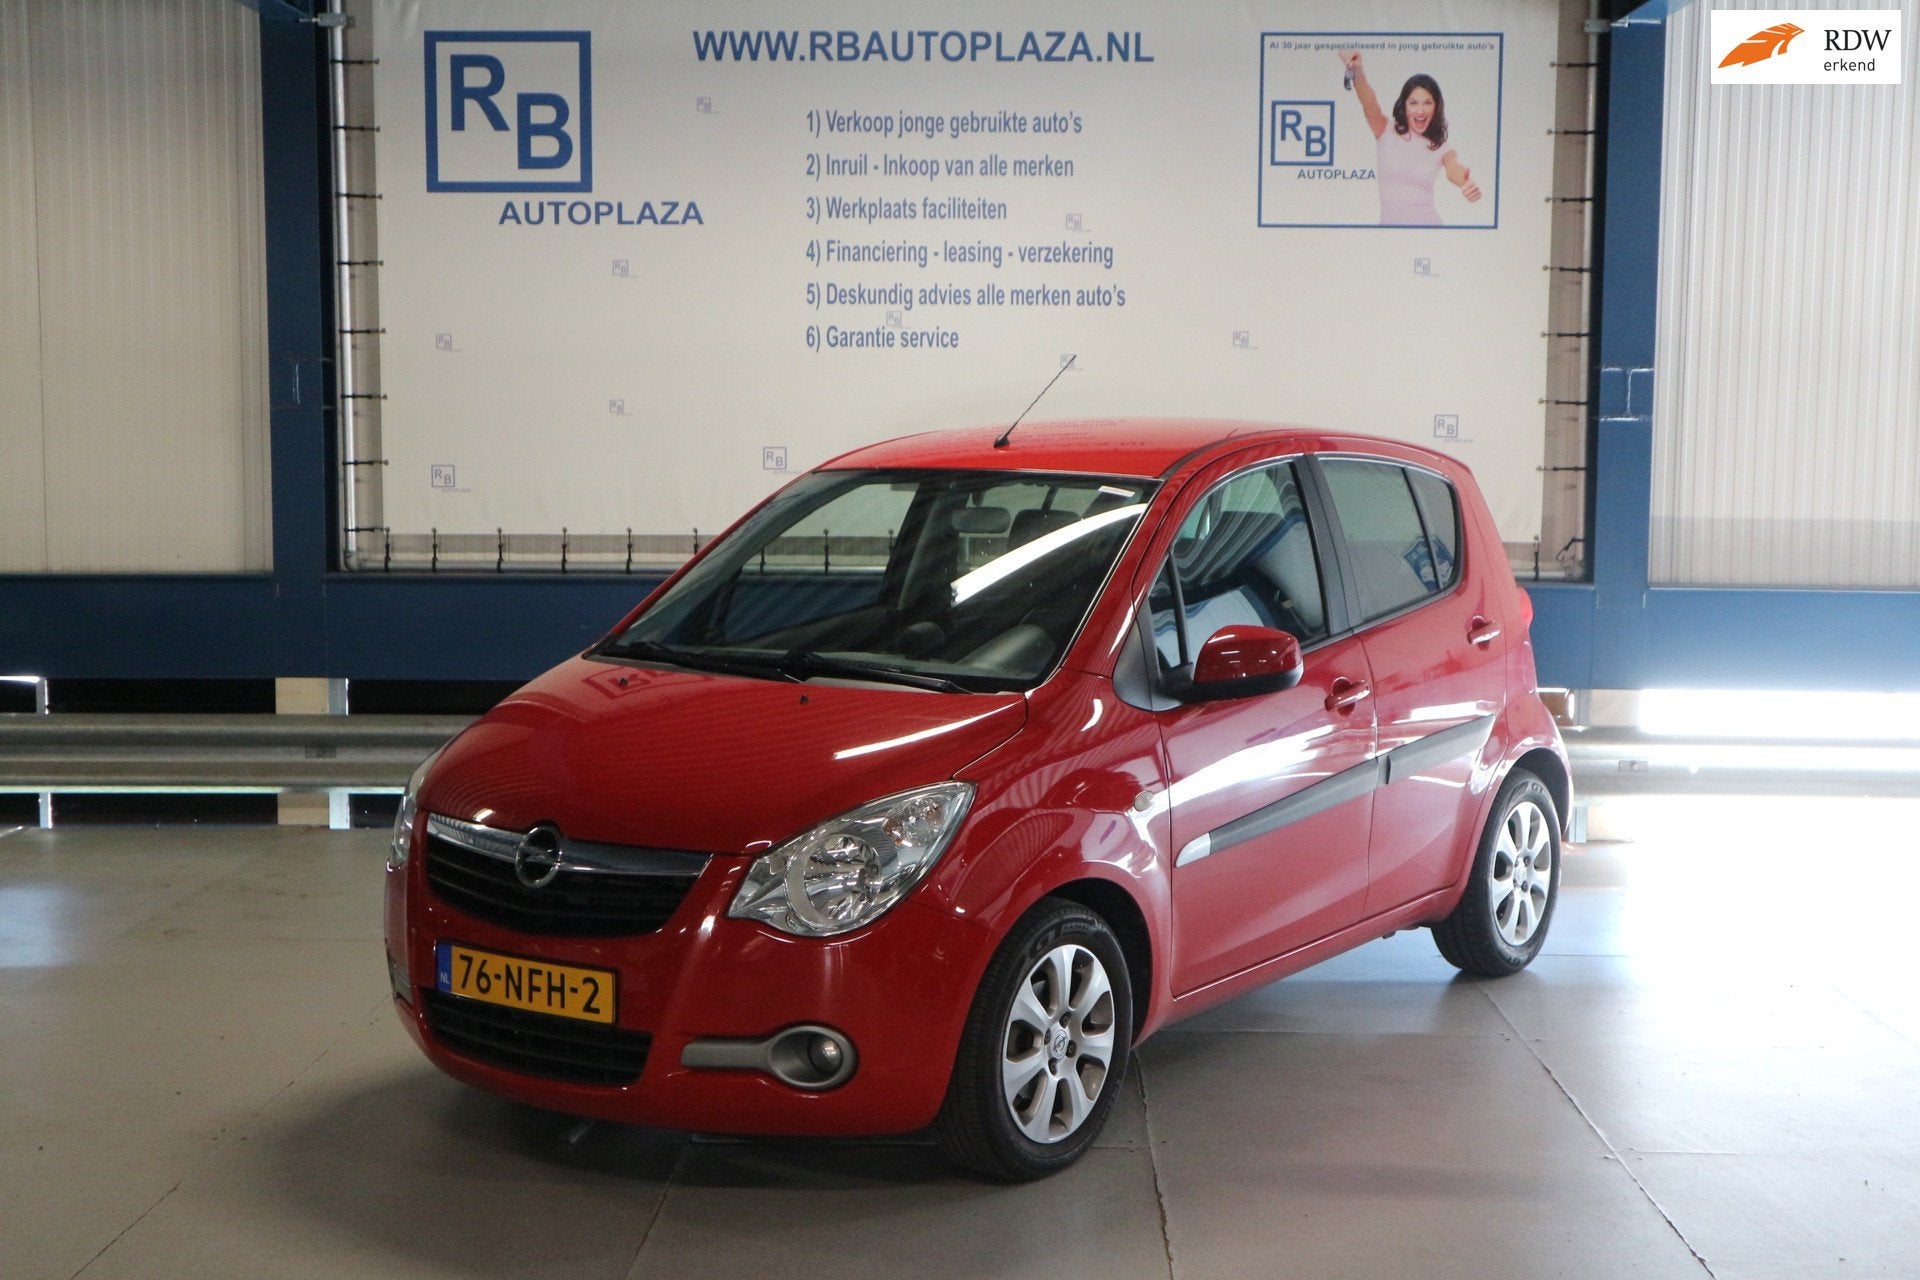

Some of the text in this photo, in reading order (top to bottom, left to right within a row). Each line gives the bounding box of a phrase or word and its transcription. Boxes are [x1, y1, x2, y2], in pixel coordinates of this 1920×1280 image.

[692, 30, 1155, 62] WWW.RBAUTOPLAZA.NL
[1282, 41, 1292, 49] 30
[1294, 42, 1311, 51] jaar
[1314, 41, 1386, 51] gespecialiseerd
[1388, 42, 1396, 50] in
[1398, 42, 1419, 51] jong
[1421, 42, 1465, 51] gebruikte
[449, 53, 574, 170] RB
[806, 110, 1083, 138] 1) Verkoop jonge gebruikte auto’s
[1280, 109, 1328, 157] RB
[806, 154, 821, 181] 2)
[826, 154, 868, 176] Inruil
[883, 154, 940, 181] Inkoop
[945, 159, 974, 176] van
[979, 155, 1008, 177] alle
[1013, 155, 1074, 177] merken
[1297, 168, 1377, 181] AUTOPLAZA
[498, 200, 705, 226] AUTOPLAZA
[806, 197, 1007, 225] 3) Werkplaats faciliteiten
[805, 239, 821, 268] 4)
[826, 240, 928, 268] Financiering
[943, 241, 1002, 269] leasing
[1018, 241, 1114, 269] verzekering
[806, 283, 1126, 311] 5) Deskundig advies alle merken auto’s
[806, 325, 959, 353] 6) Garantie service
[440, 972, 451, 984] NL
[459, 954, 601, 1014] 76-NFH-2
